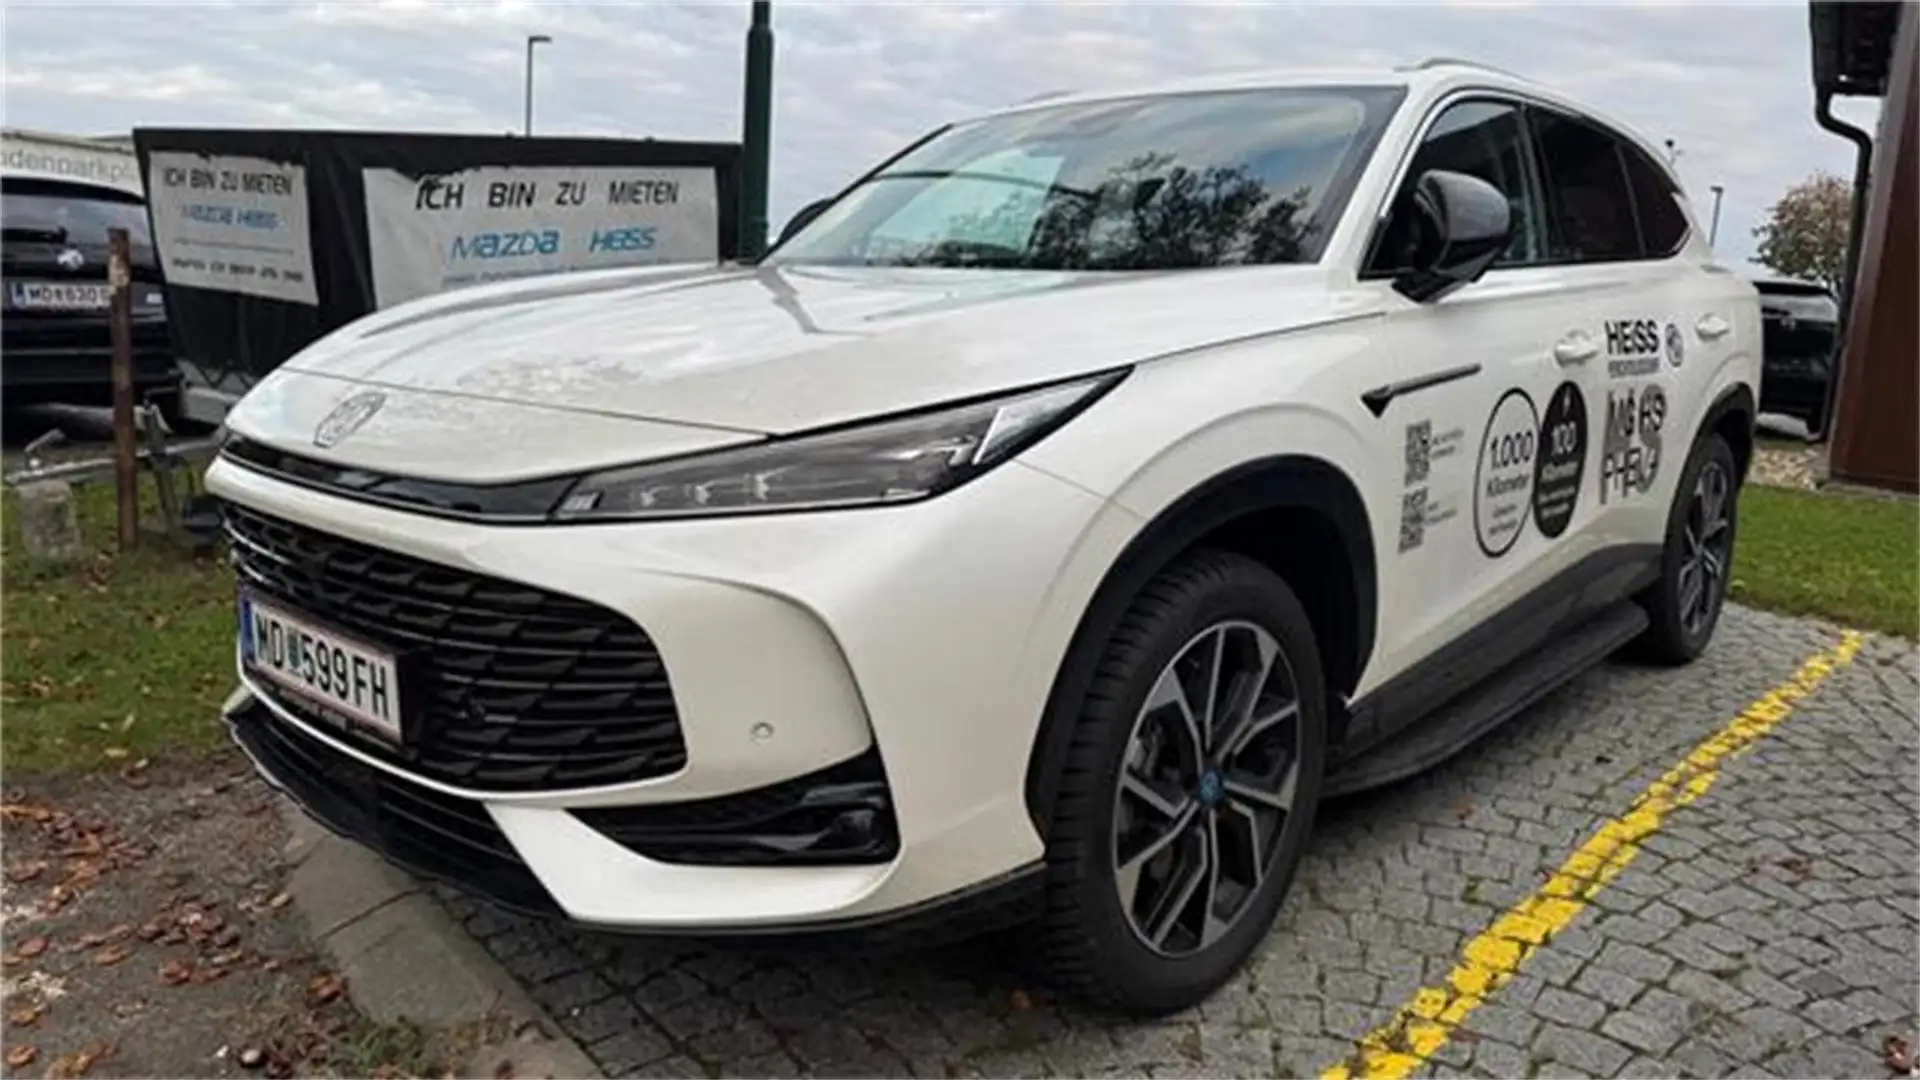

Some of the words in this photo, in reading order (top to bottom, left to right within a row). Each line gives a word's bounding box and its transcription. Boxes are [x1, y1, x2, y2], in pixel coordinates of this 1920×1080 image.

[415, 179, 464, 211] ICH
[488, 181, 536, 208] BIN
[555, 181, 586, 207] ZU
[608, 180, 680, 206] MIETEN
[254, 612, 284, 670] MD
